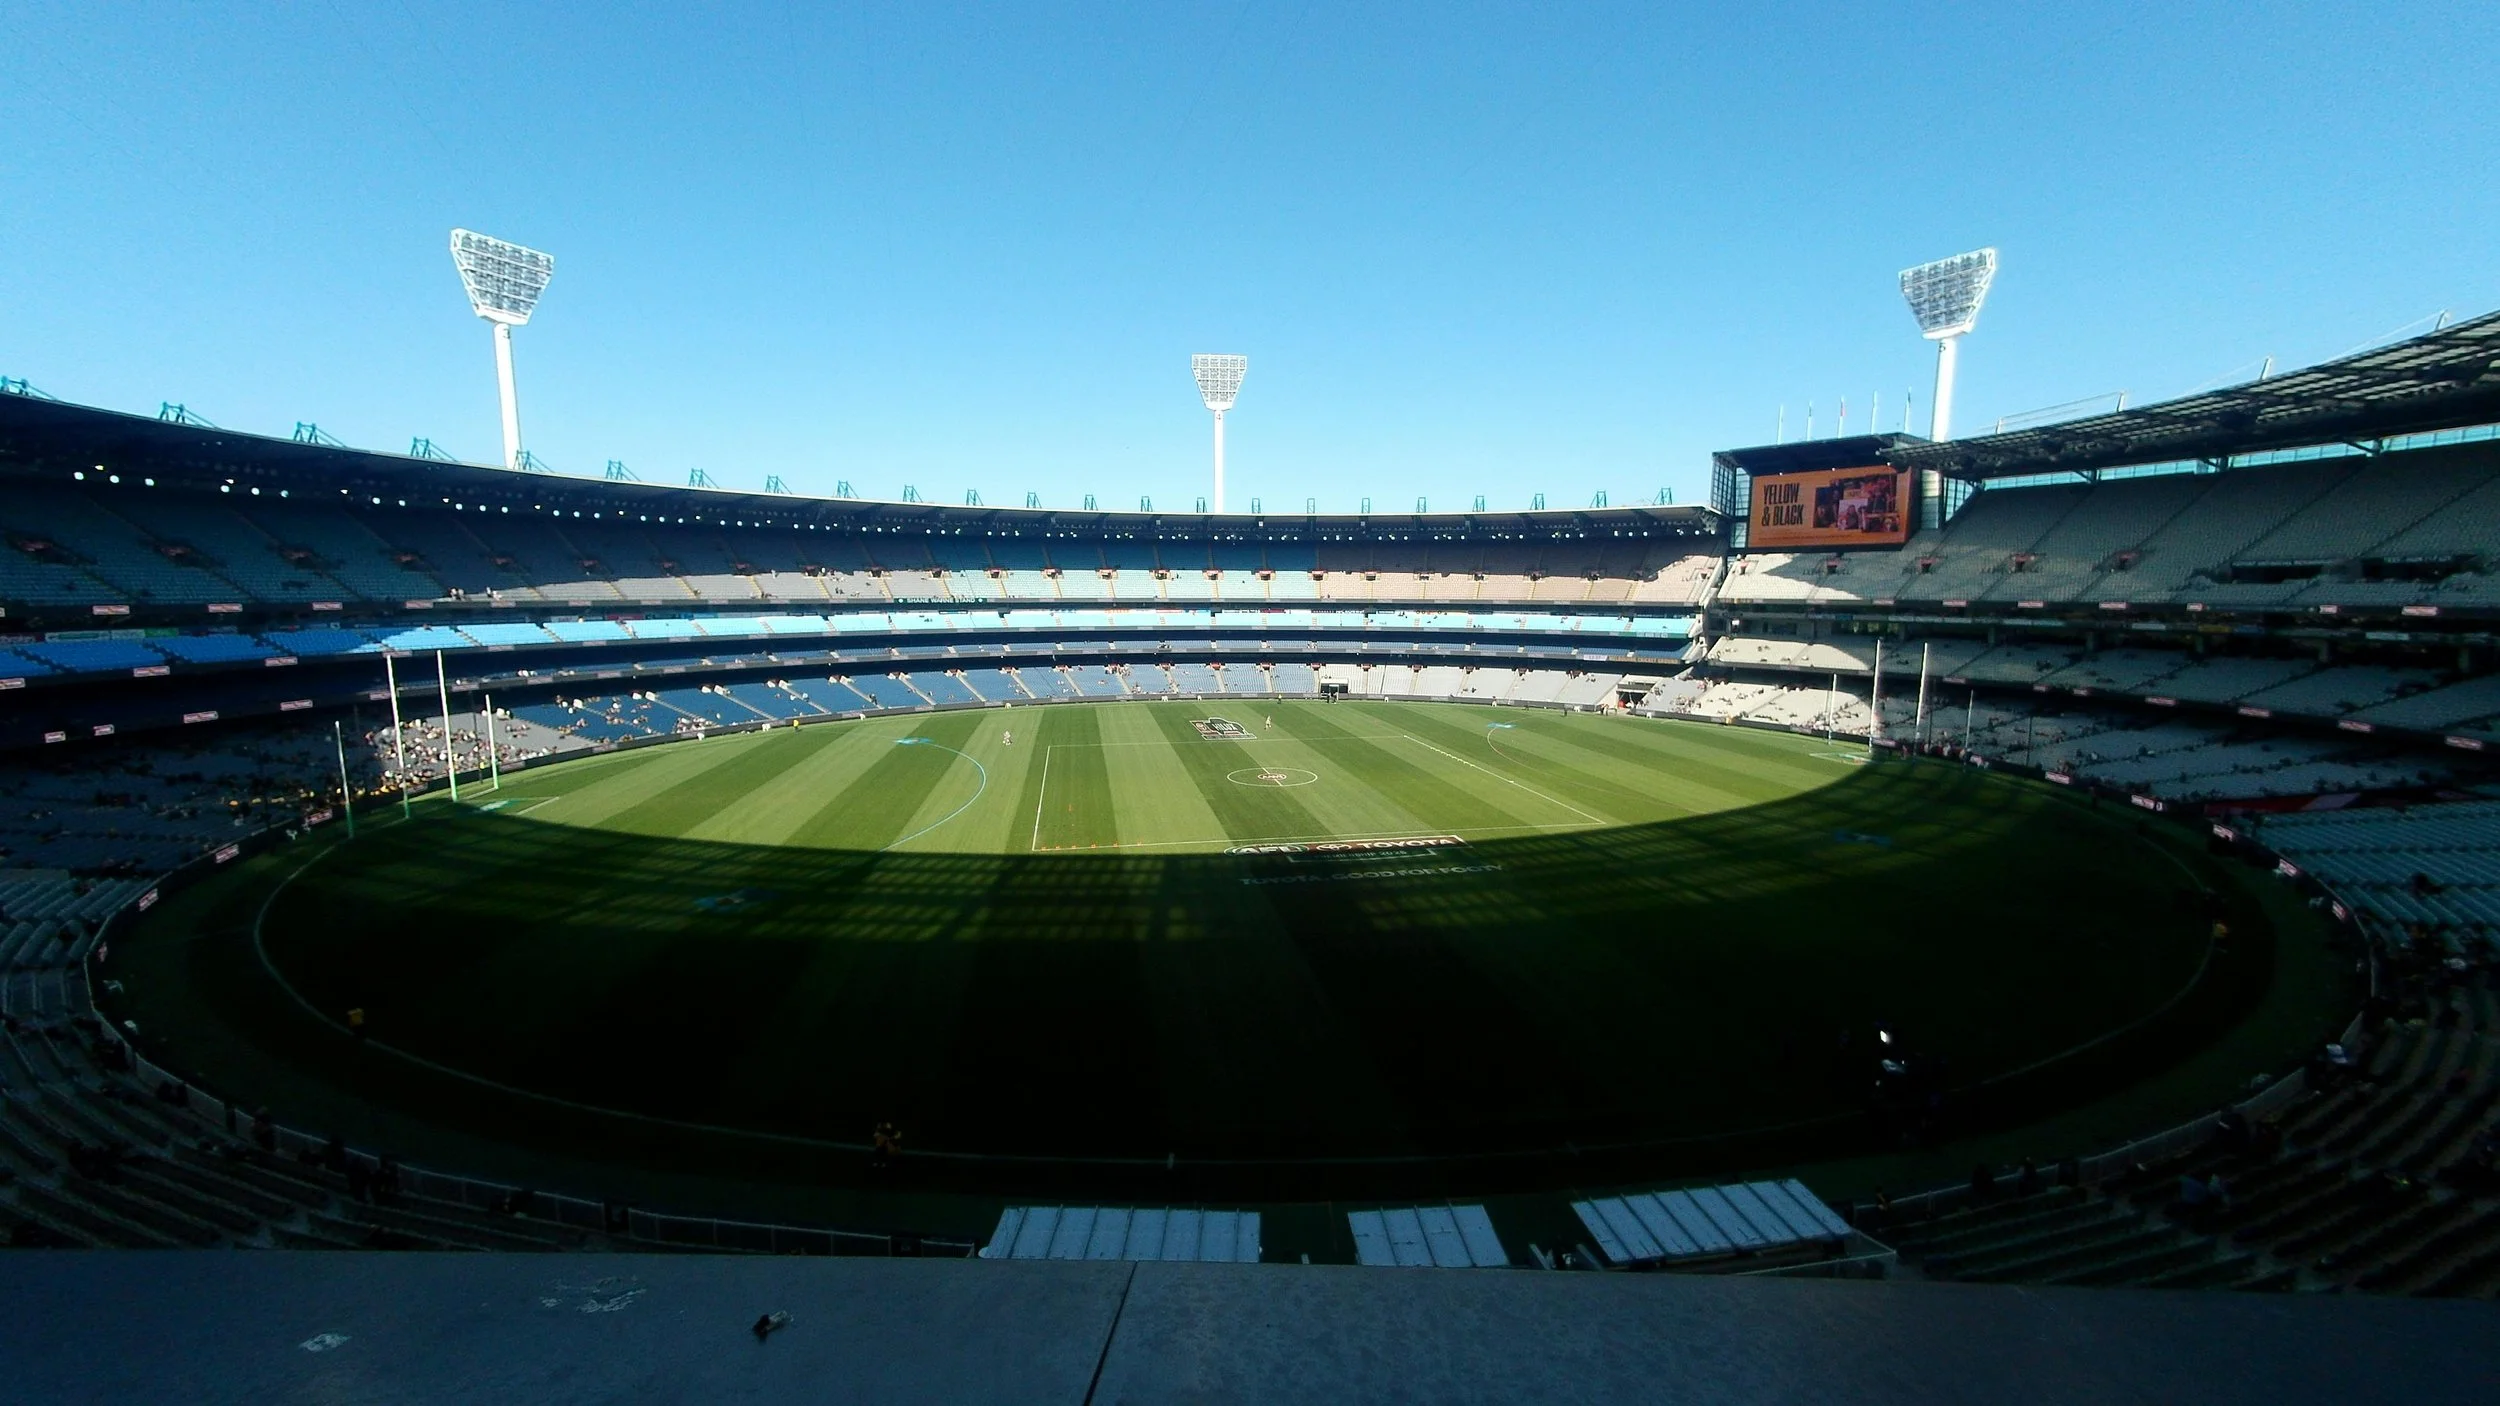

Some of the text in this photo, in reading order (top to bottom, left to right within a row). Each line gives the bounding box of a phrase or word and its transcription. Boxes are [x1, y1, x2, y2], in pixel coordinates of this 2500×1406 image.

[1764, 483, 1800, 505] YELLOW
[1762, 505, 1804, 526] & BLACK
[1237, 840, 1456, 855] AFL TOYOTA
[1331, 871, 1395, 880] GOOD
[1396, 868, 1438, 876] FOR
[1439, 865, 1502, 874] FOOTY
